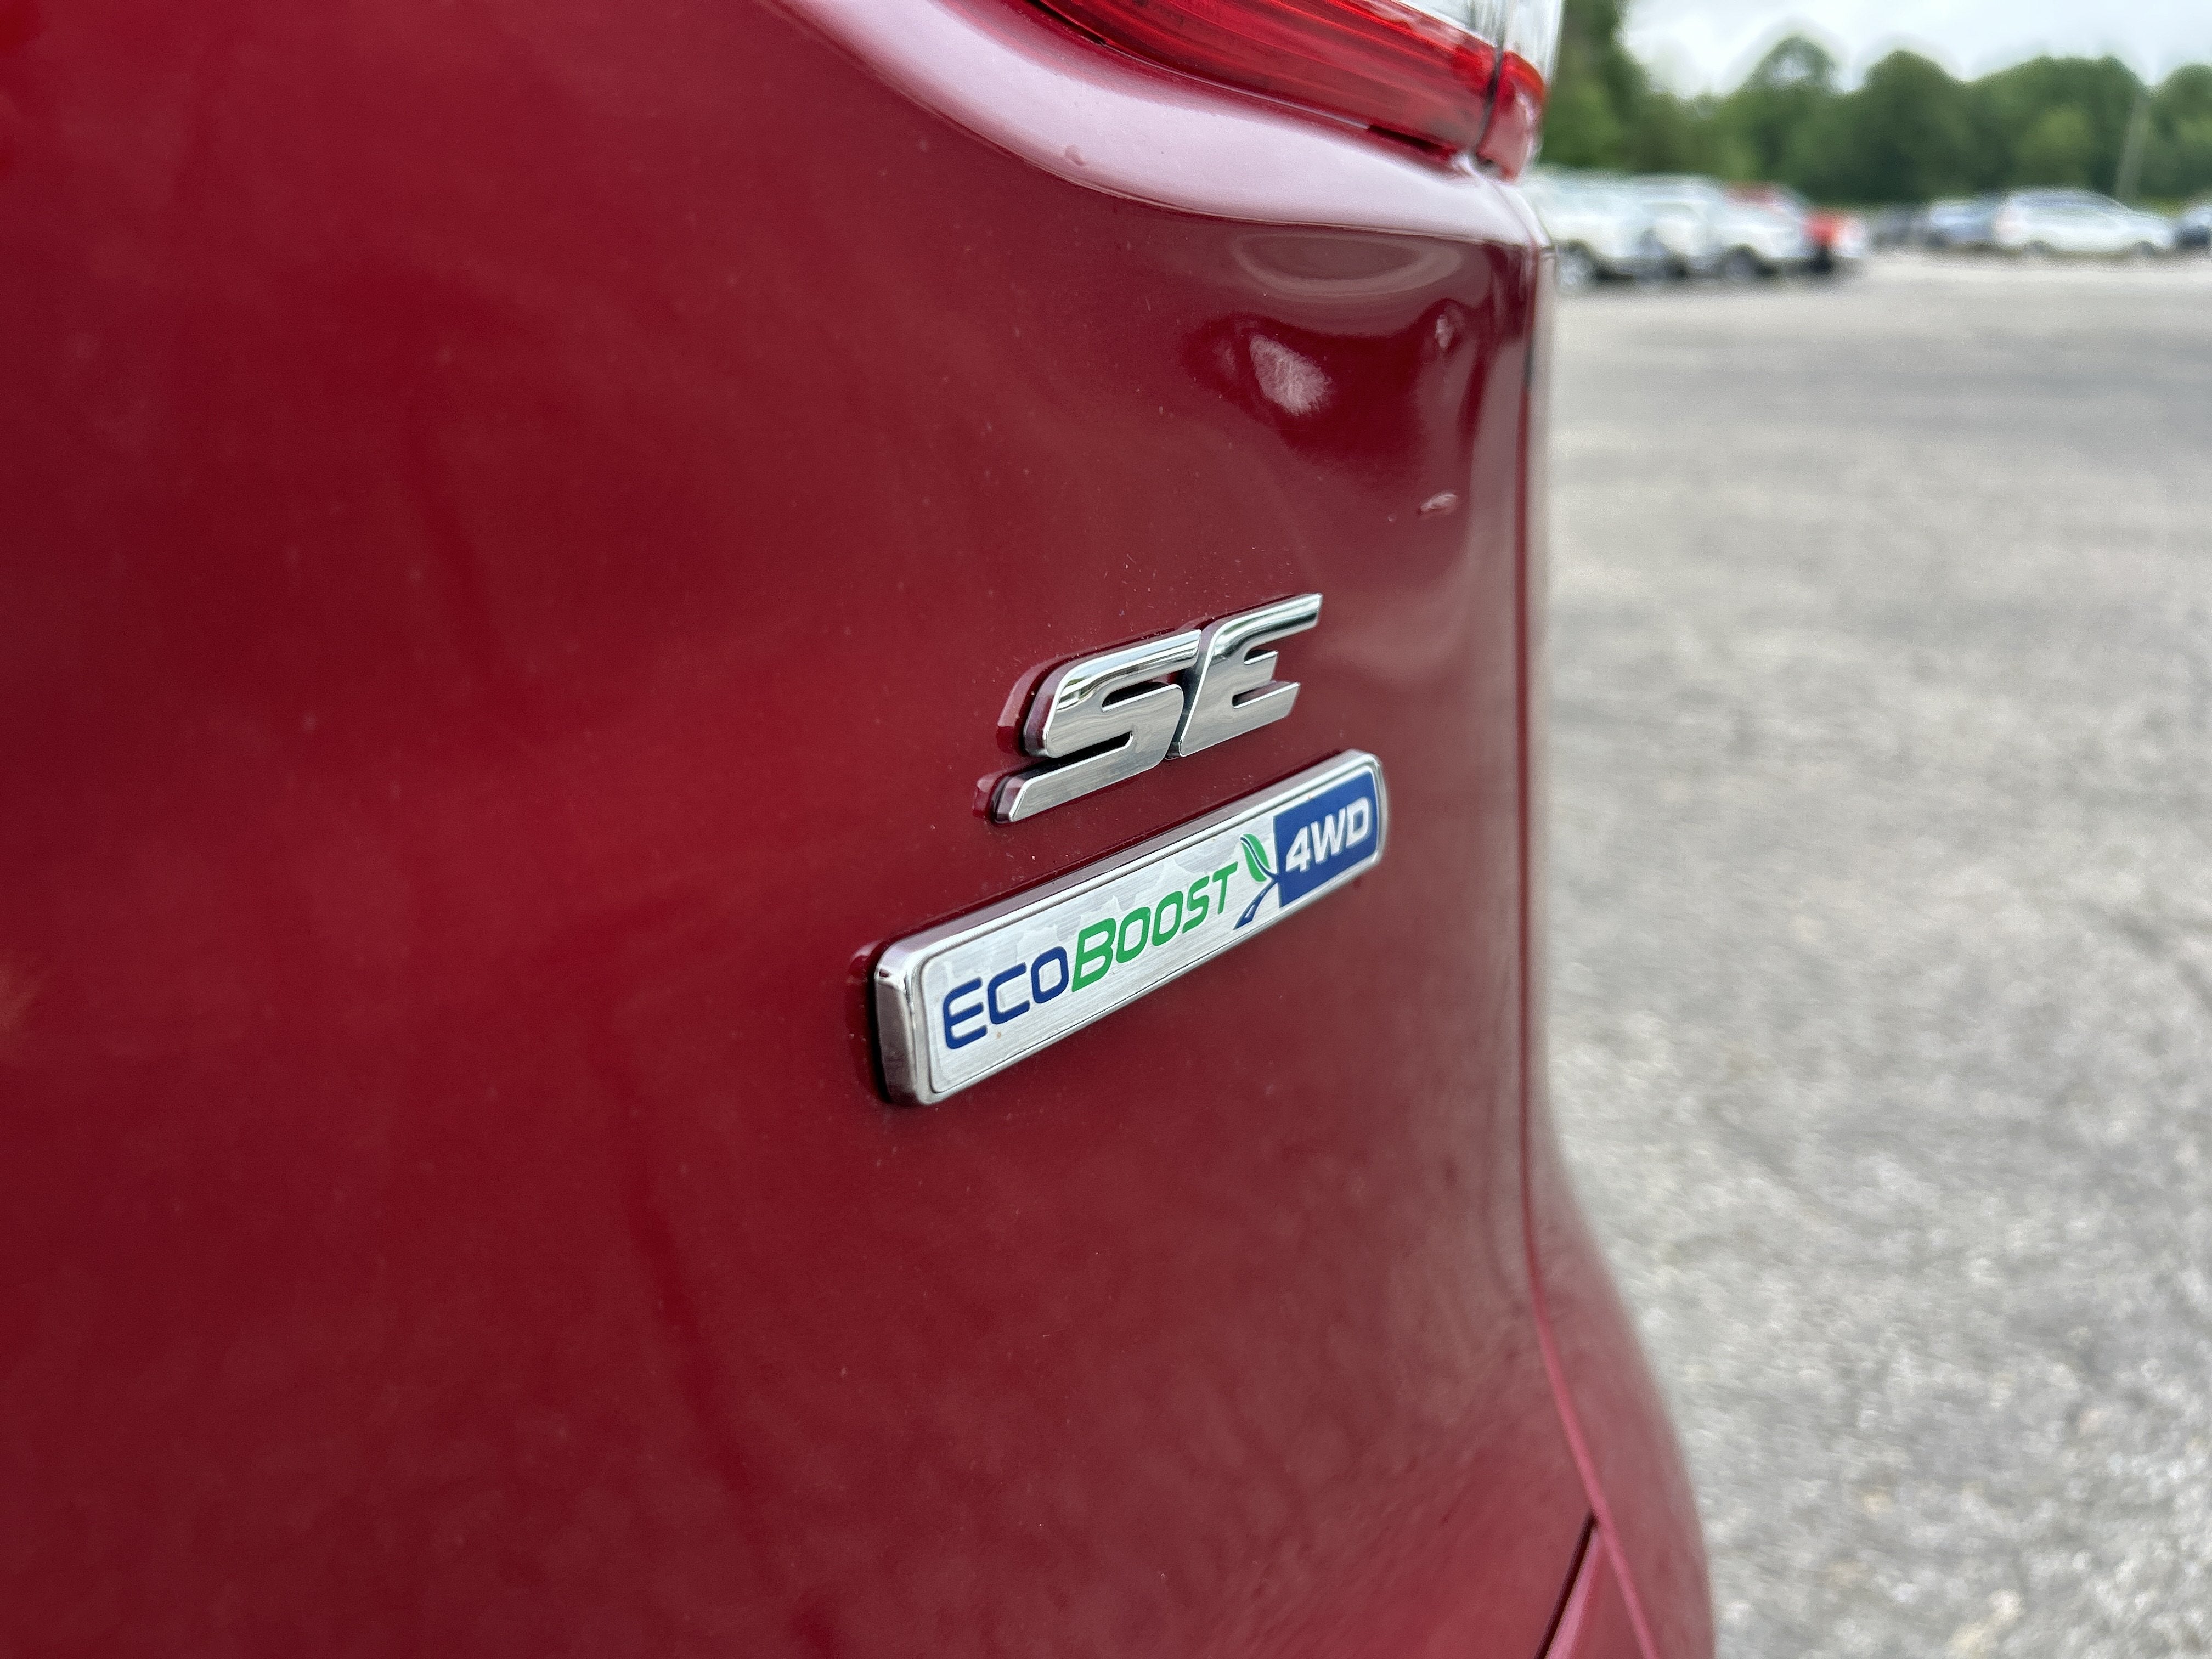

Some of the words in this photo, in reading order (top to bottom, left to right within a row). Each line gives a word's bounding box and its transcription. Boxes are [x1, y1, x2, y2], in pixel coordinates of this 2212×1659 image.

[992, 593, 1323, 823] SE
[942, 862, 1238, 1049] ECOBOOST
[1284, 799, 1370, 872] 4WD
